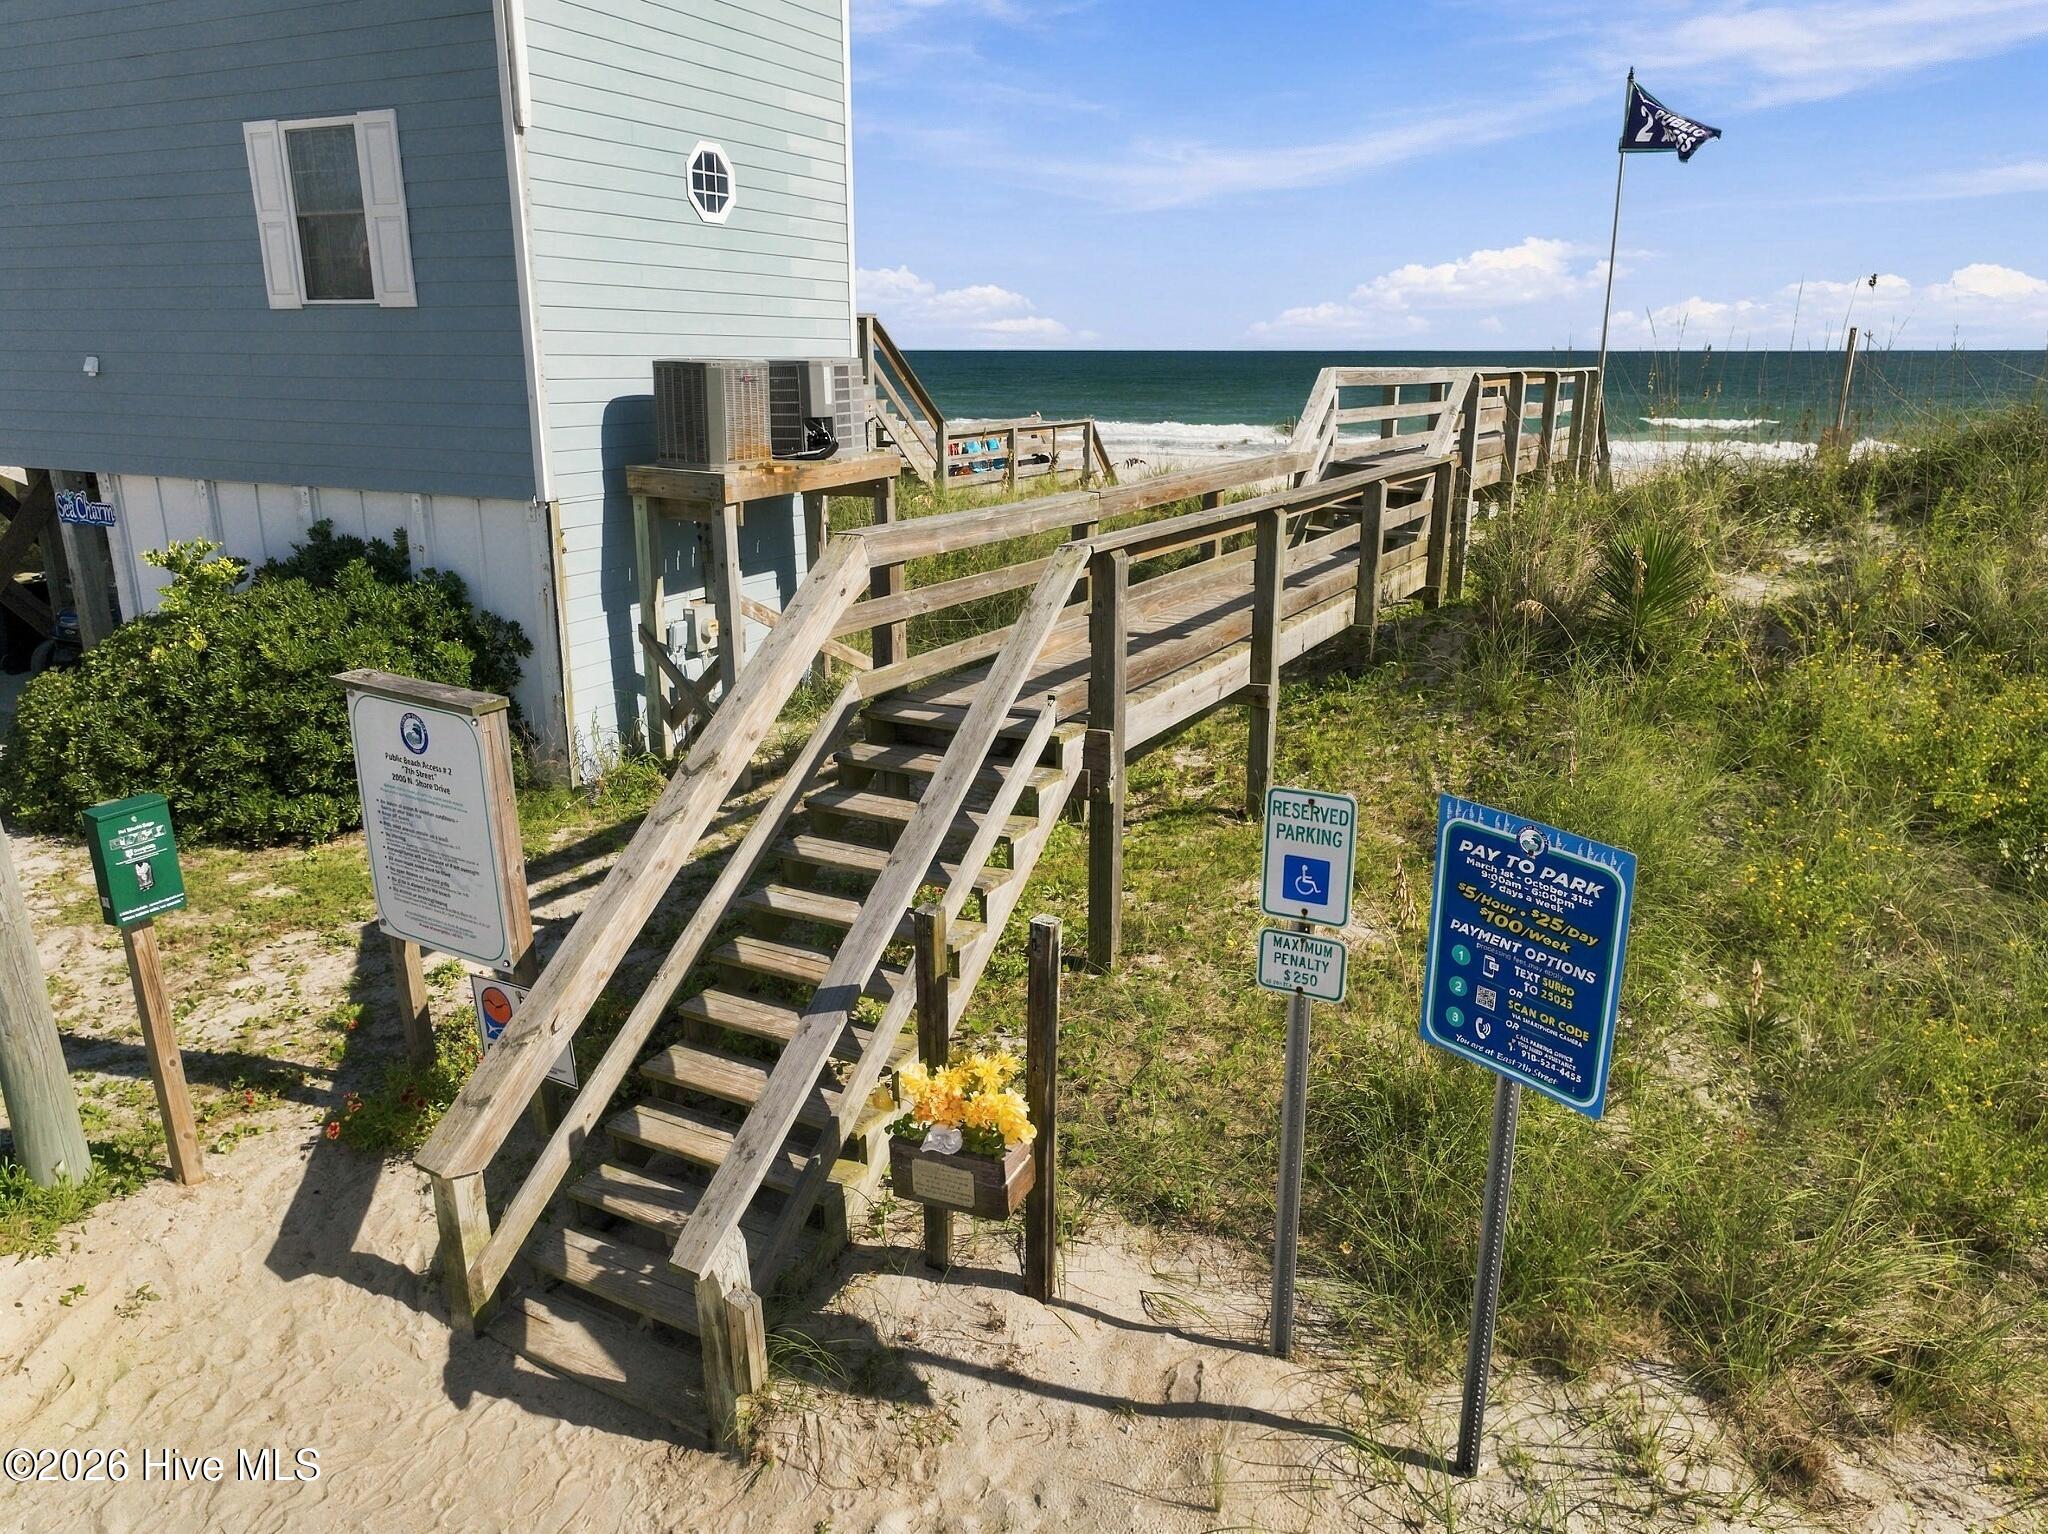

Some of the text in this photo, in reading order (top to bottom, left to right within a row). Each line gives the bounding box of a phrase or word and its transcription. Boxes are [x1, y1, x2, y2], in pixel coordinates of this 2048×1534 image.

[1634, 105, 1654, 143] 2
[56, 493, 116, 521] Sea Charm
[384, 752, 402, 763] Public
[403, 756, 421, 768] Beach
[422, 761, 442, 773] Access
[448, 767, 452, 776] 2
[415, 779, 433, 790] Shore
[434, 783, 451, 795] Drive
[1272, 800, 1349, 826] RESERVED
[1276, 823, 1343, 848] PARKING
[1458, 839, 1605, 899] PAY TO PARK
[1466, 856, 1497, 874] March
[1500, 868, 1515, 880] 1st
[1524, 877, 1569, 898] October
[1570, 893, 1594, 908] 31st
[1481, 870, 1522, 891] 9:00am
[1531, 889, 1575, 910] 6:00pm
[1489, 882, 1564, 914] 7 days a week
[1458, 881, 1599, 946] $5/Hour $25/Day
[1479, 907, 1572, 954] $100/Week
[1273, 935, 1333, 958] MAXIMUM
[1450, 918, 1597, 984] PAYMENT OPTIONS
[1458, 950, 1464, 961] 1
[1274, 952, 1329, 973] PENALTY
[1514, 965, 1540, 983] TEXT
[1454, 981, 1462, 992] 2
[1508, 988, 1523, 999] OR
[1523, 981, 1573, 1010] TO 25023
[1451, 1012, 1459, 1022] 3
[1505, 1020, 1520, 1031] OR
[1507, 1000, 1590, 1042] SCAN QR CODE
[1511, 1012, 1583, 1048] VIA SMARTPHONE CAMERA
[1515, 1034, 1529, 1044] CALL
[1530, 1040, 1553, 1055] PARKING
[1517, 1041, 1529, 1050] YOU
[1529, 1046, 1543, 1056] NEED
[1544, 1053, 1577, 1072] ASSISTANCE
[1456, 1034, 1559, 1085] You are at East 7th Street
